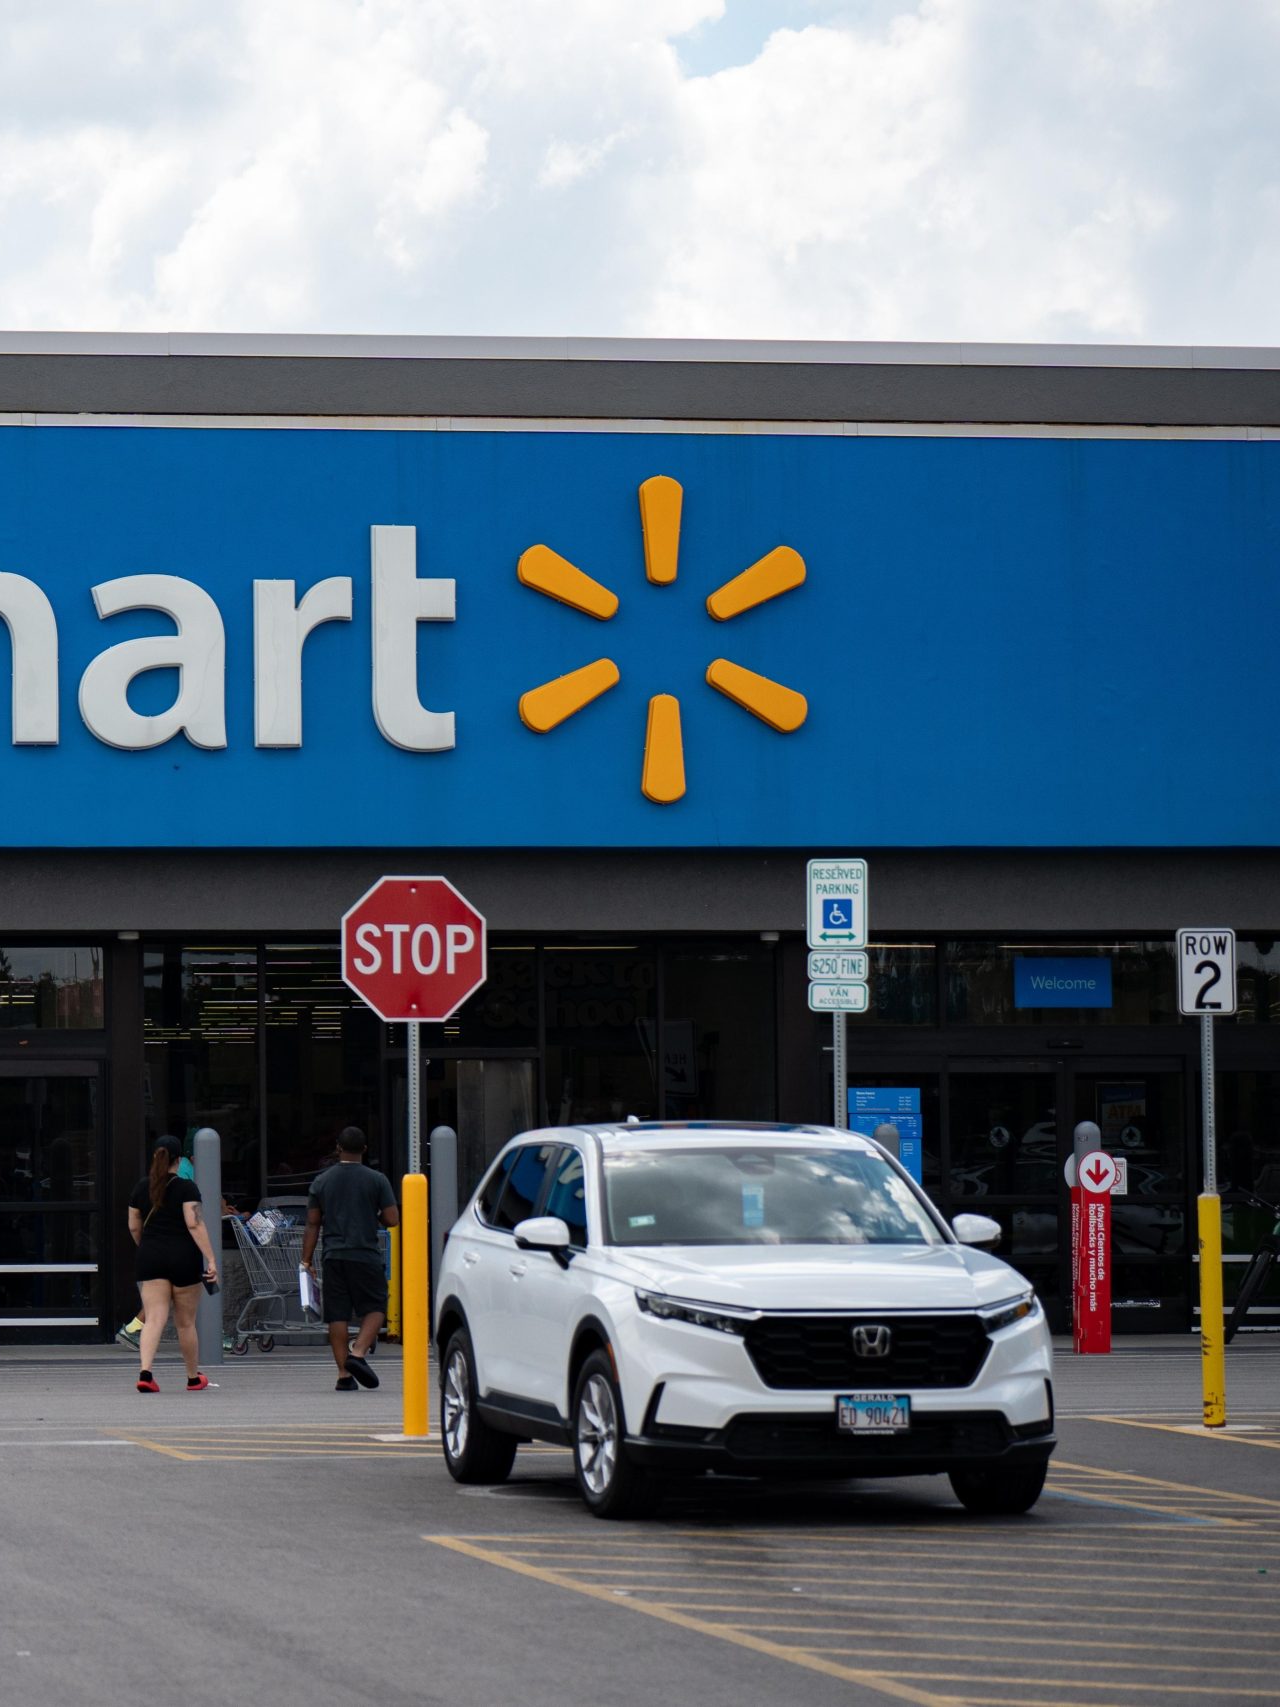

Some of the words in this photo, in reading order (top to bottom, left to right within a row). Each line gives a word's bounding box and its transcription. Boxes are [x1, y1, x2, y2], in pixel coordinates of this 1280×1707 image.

[813, 869, 862, 880] RESERVED
[816, 884, 859, 895] PARKING
[353, 923, 475, 975] STOP
[1185, 936, 1228, 956] ROW
[813, 959, 837, 975] $250
[841, 959, 863, 975] FINE
[1030, 976, 1097, 990] Welcome
[1195, 960, 1222, 1010] 2
[829, 988, 849, 997] VAN
[1097, 1232, 1105, 1267] Cientos
[1097, 1268, 1105, 1280] de
[1090, 1291, 1098, 1312] más
[853, 1394, 895, 1402] GERALD
[841, 1407, 857, 1426] ED
[866, 1407, 907, 1426] 90421
